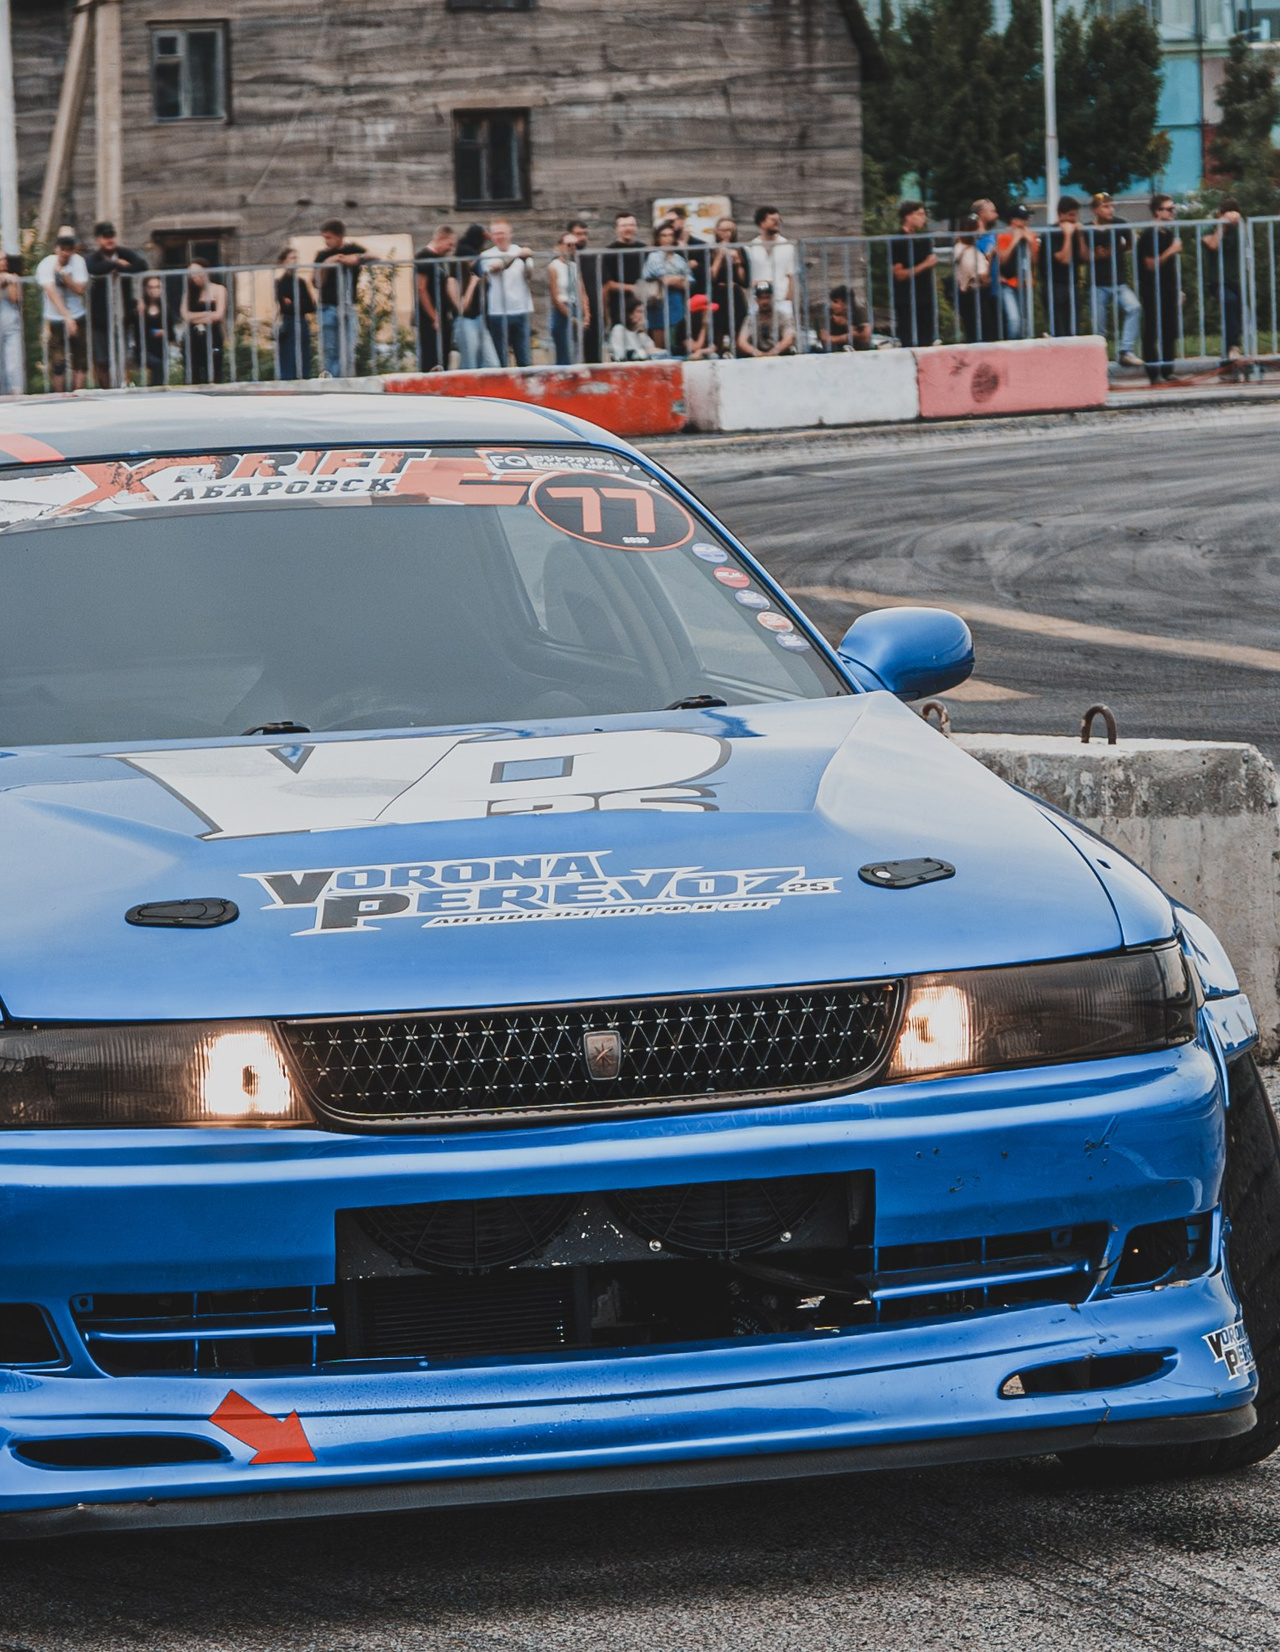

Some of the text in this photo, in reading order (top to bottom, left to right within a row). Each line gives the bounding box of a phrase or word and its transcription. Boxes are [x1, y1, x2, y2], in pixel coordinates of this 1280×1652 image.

[546, 487, 656, 533] 77
[260, 852, 601, 905] VORONA
[317, 867, 805, 930] PEREVOZ
